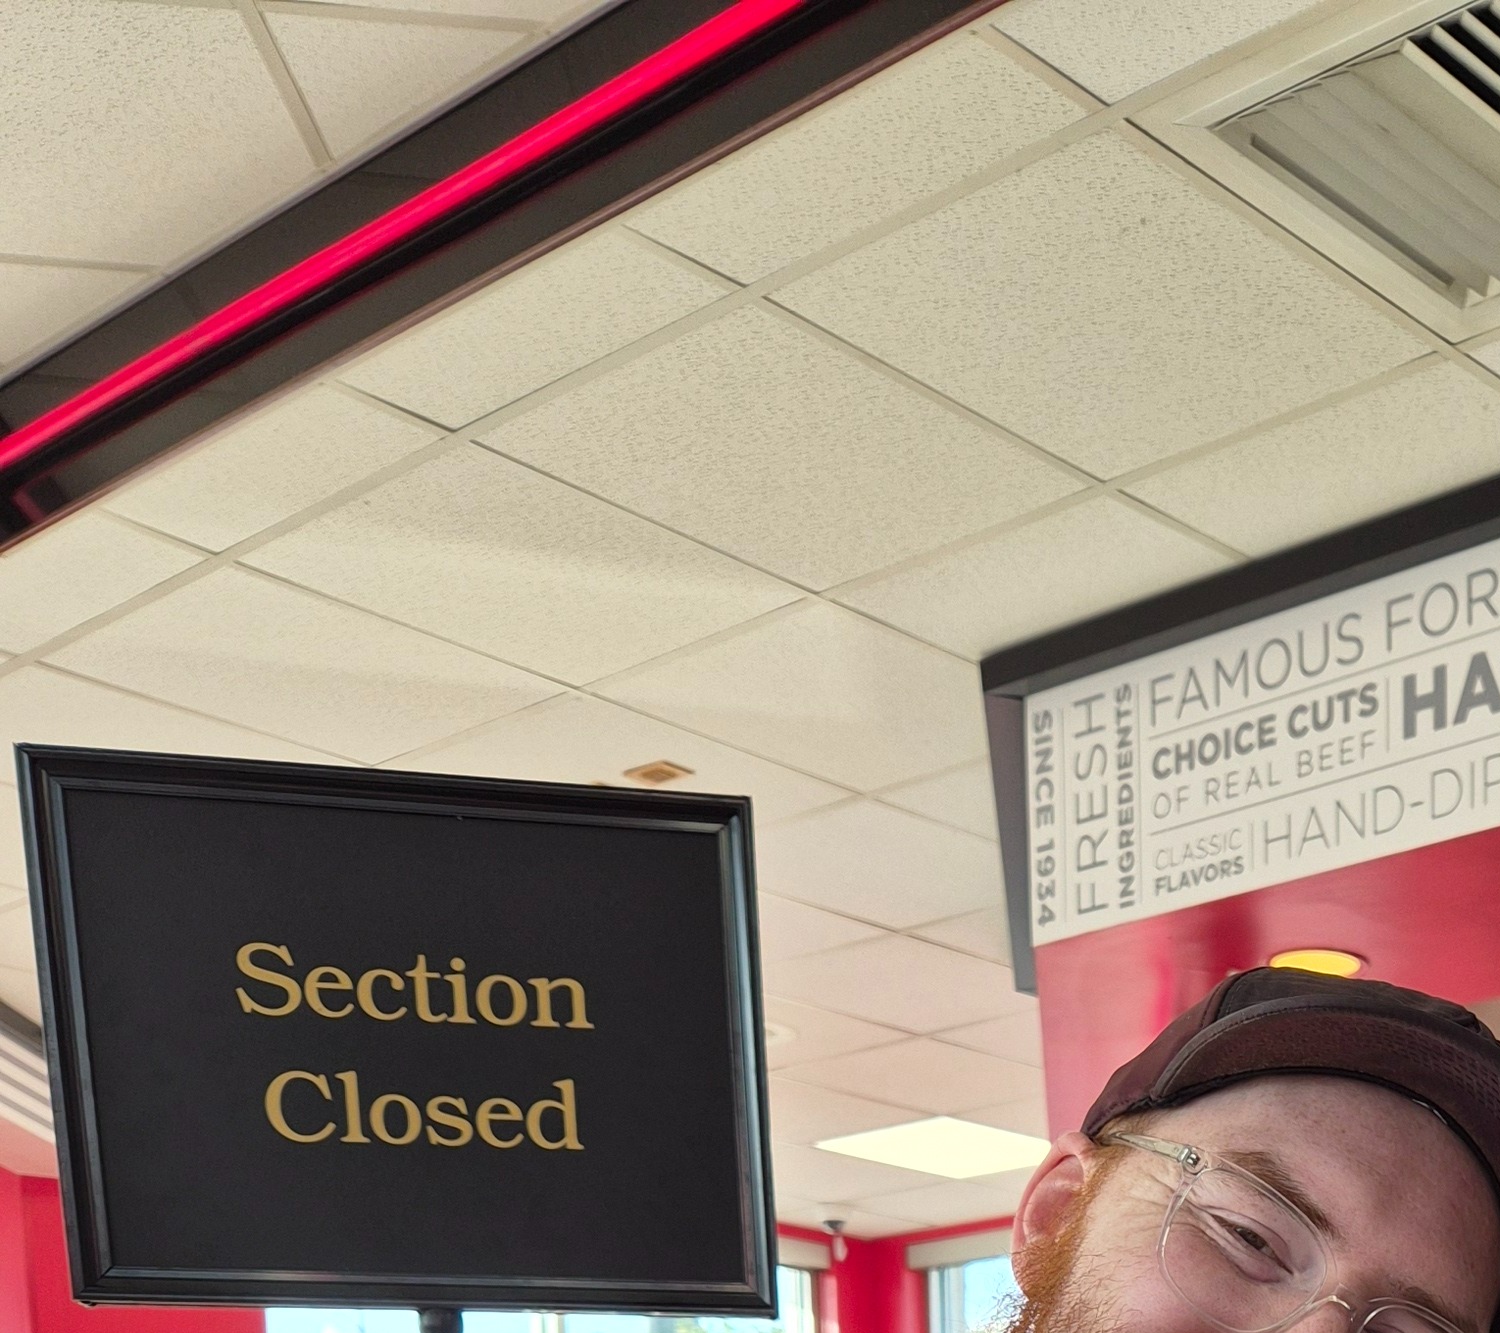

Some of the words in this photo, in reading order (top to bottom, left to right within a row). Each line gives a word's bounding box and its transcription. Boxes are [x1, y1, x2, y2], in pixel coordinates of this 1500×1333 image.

[1149, 612, 1365, 729] FAMOUS
[1385, 567, 1499, 652] FOR
[1032, 709, 1056, 829] SINCE
[1152, 714, 1278, 781] CHOICE
[1287, 683, 1380, 740] CUTS
[1152, 785, 1191, 821] OF
[1204, 758, 1283, 805] REAL
[1296, 729, 1377, 779] BEEF
[1073, 691, 1109, 917] FRESH
[1114, 682, 1136, 910] INGREDIENTS
[1035, 840, 1057, 928] 1934
[1154, 828, 1243, 872] CLASSIC
[1154, 855, 1245, 898] FLAVORS
[235, 942, 595, 1030] Section
[264, 1070, 586, 1151] Closed
